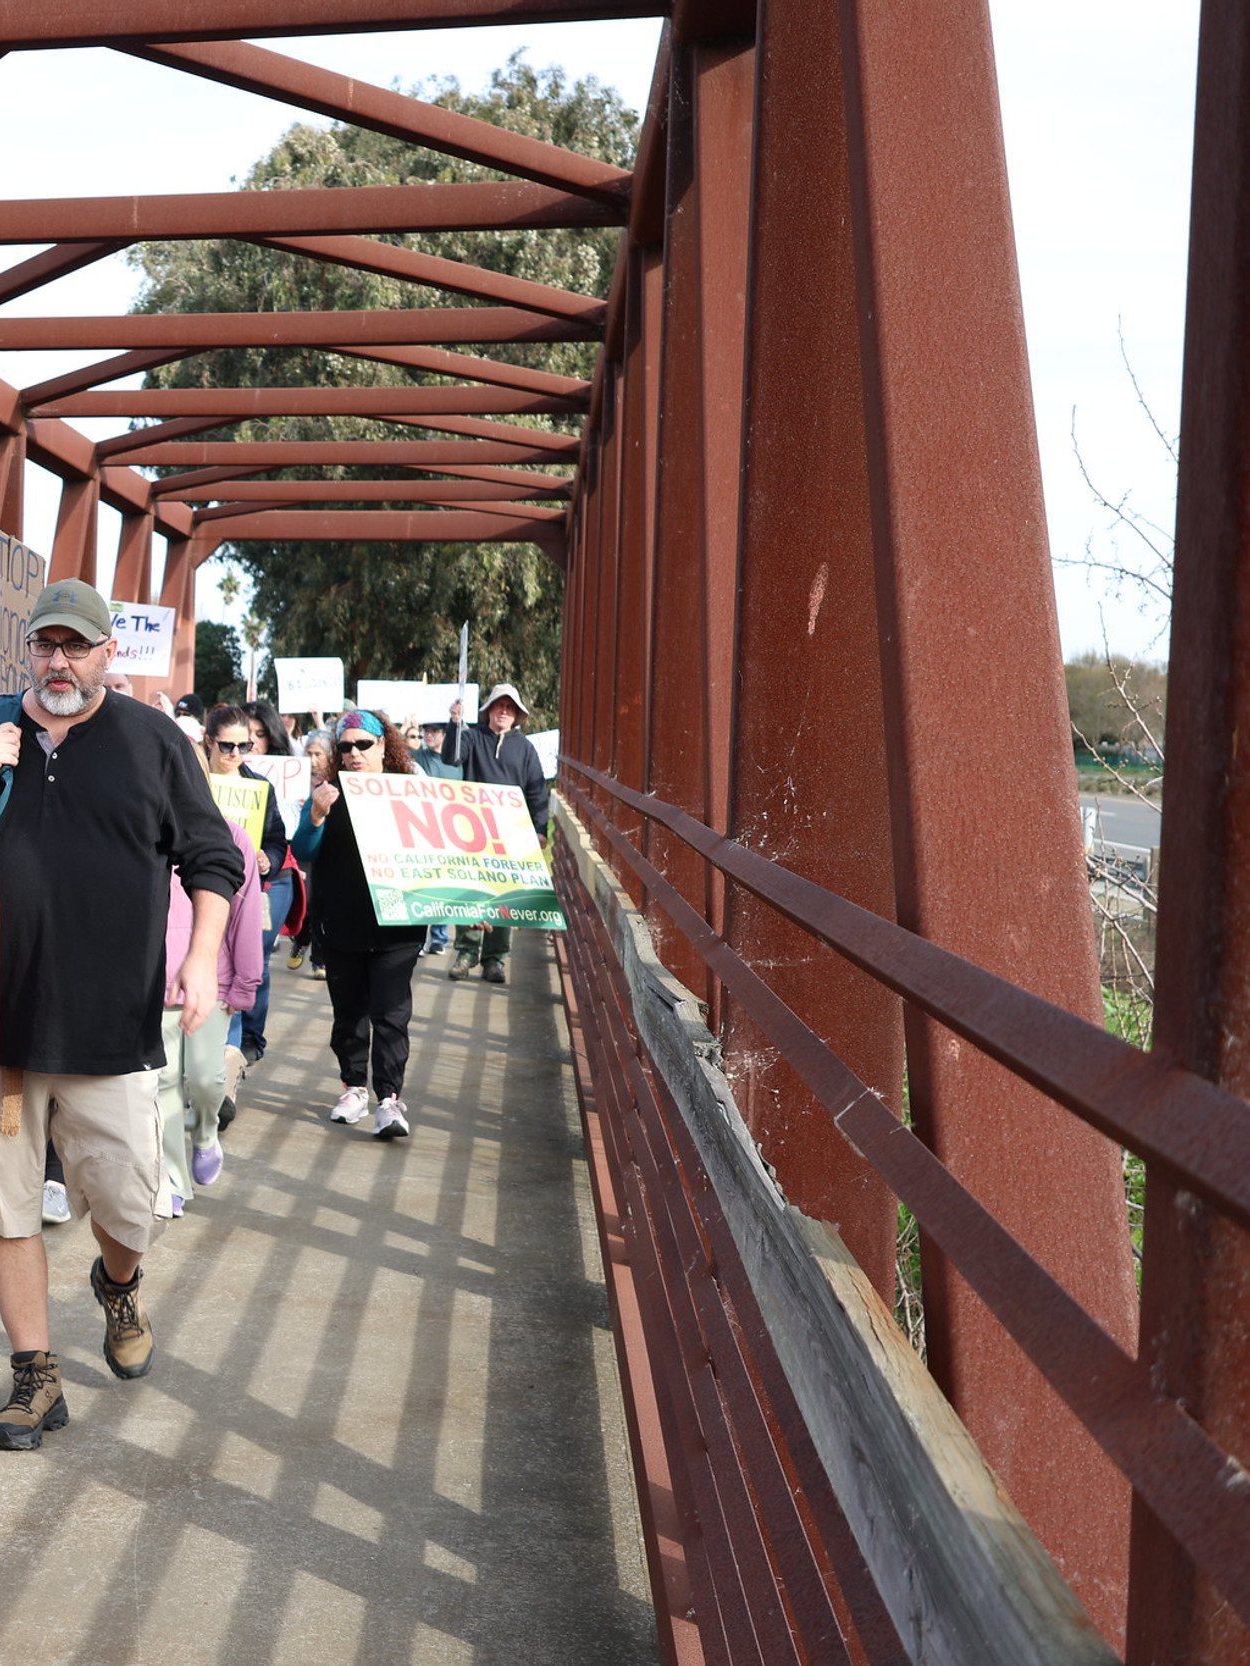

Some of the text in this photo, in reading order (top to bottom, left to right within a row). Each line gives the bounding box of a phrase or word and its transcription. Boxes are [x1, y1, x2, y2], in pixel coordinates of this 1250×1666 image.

[130, 615, 161, 633] The
[116, 645, 155, 661] nds!!!
[212, 785, 263, 811] UISUN
[346, 776, 523, 808] SOLANO SAYS
[390, 799, 507, 855] NO!
[367, 854, 543, 872] NO CALIFORNIA FOREVER
[371, 868, 550, 887] NO EAST SOLANO PLAN
[410, 901, 563, 926] CaliforniaForNever.org
